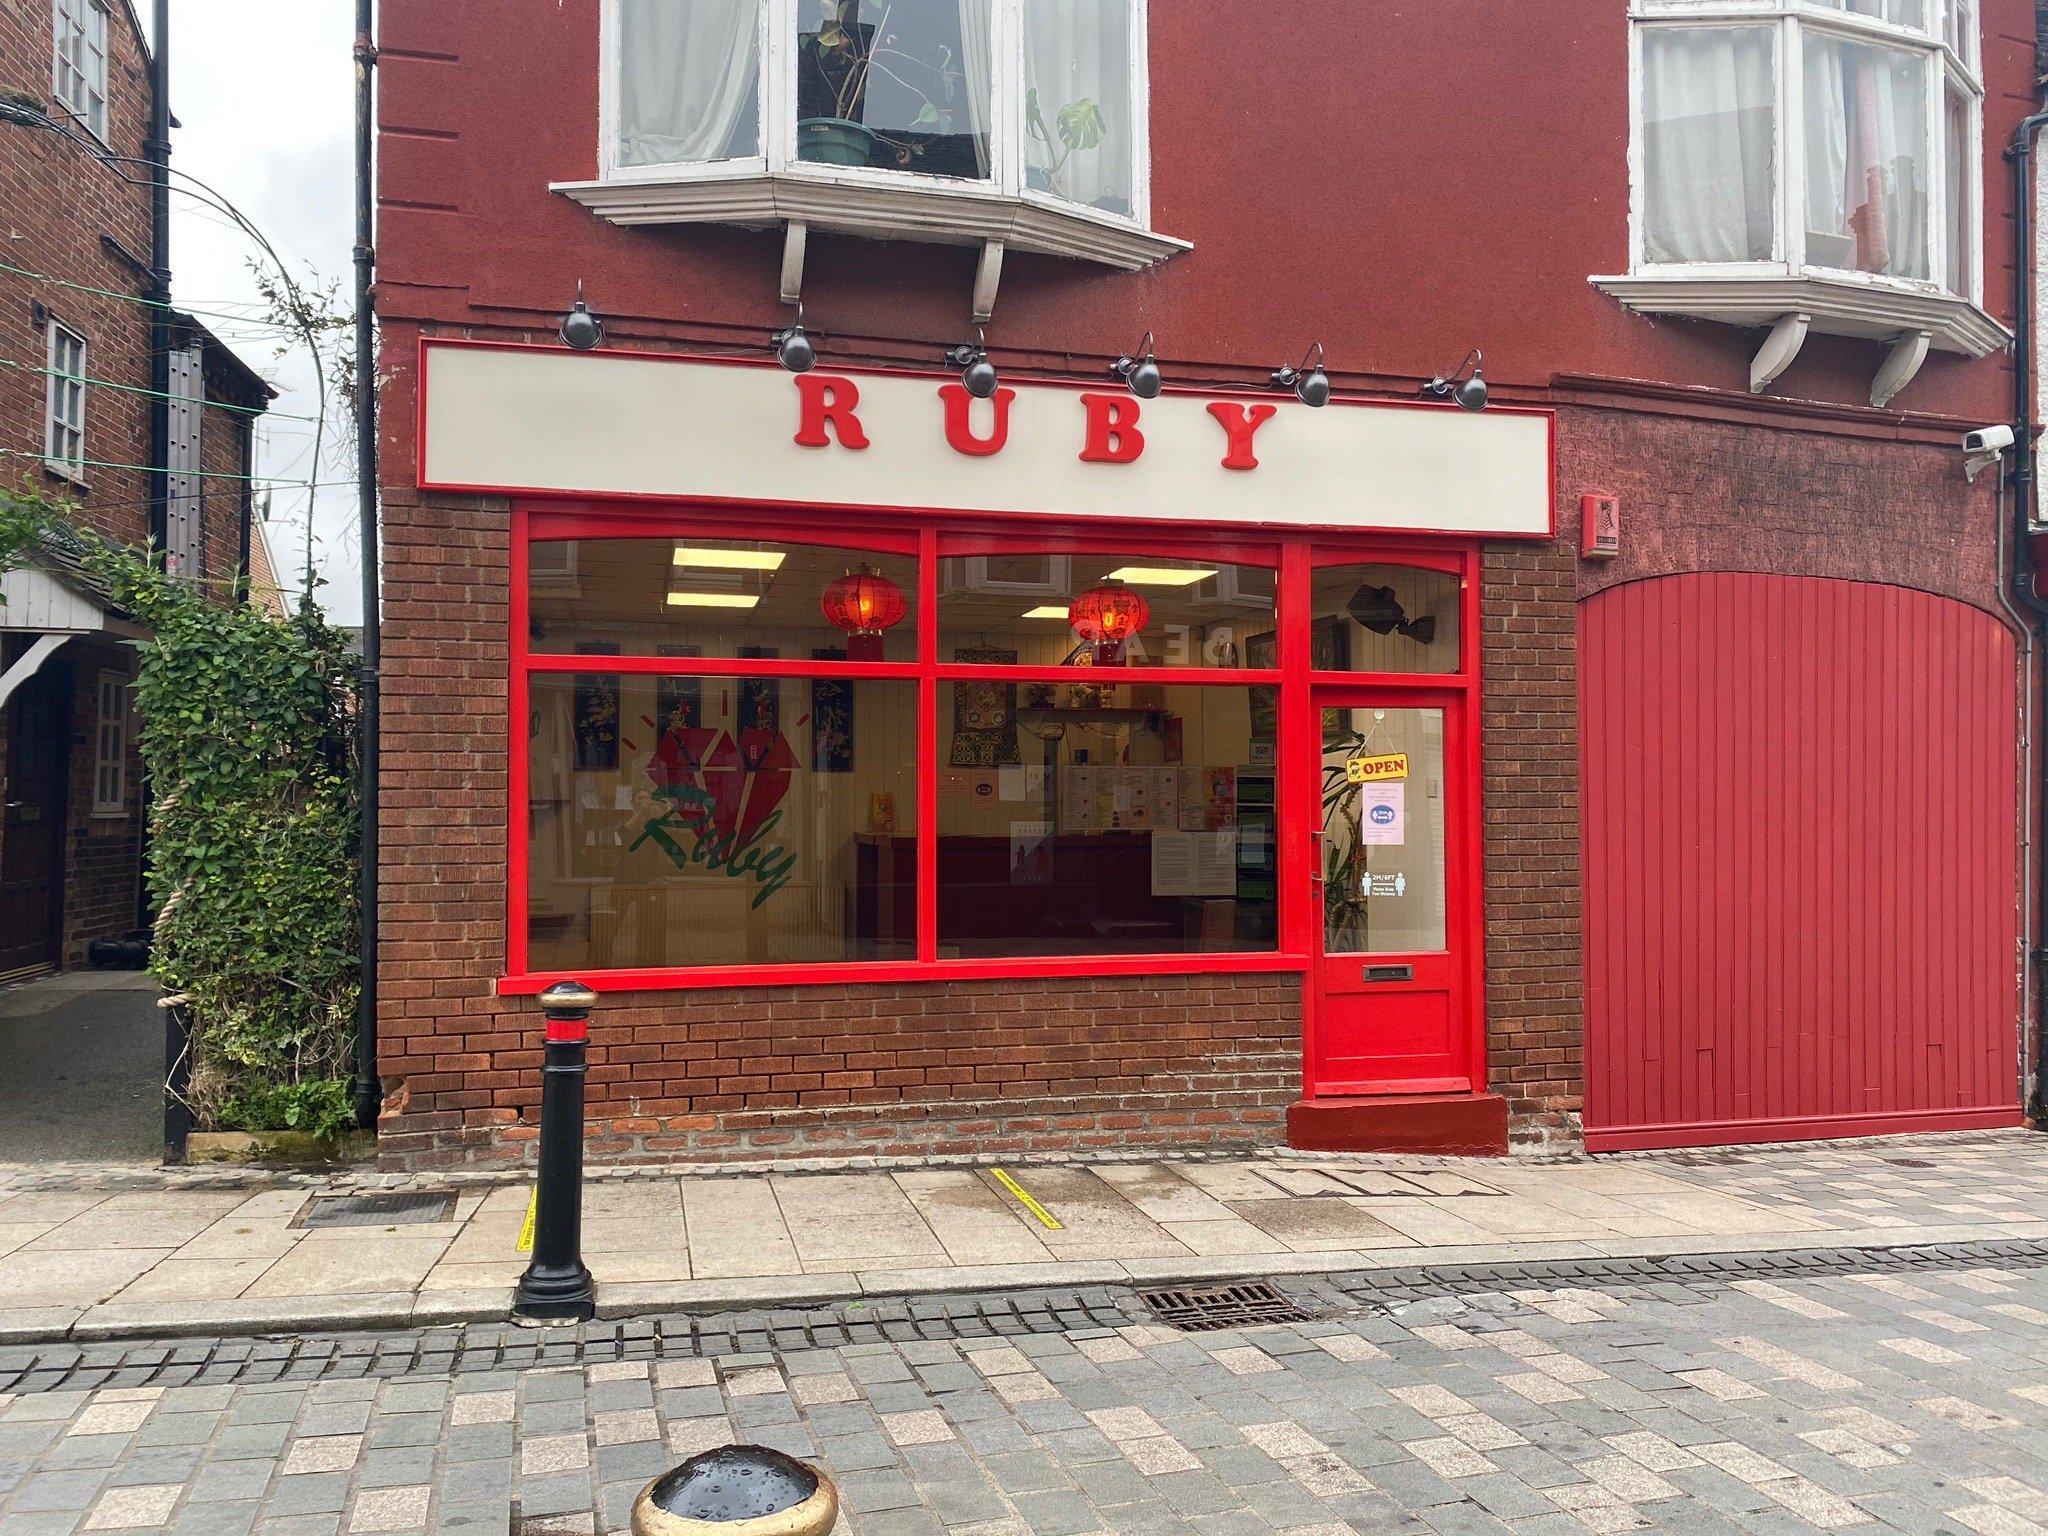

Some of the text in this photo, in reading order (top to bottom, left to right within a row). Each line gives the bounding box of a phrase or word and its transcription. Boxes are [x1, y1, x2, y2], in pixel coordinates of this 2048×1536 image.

[793, 373, 1278, 470] RUBY
[1363, 760, 1405, 775] OPEN
[629, 784, 798, 911] Ruby
[1372, 874, 1396, 882] 2M/6FT
